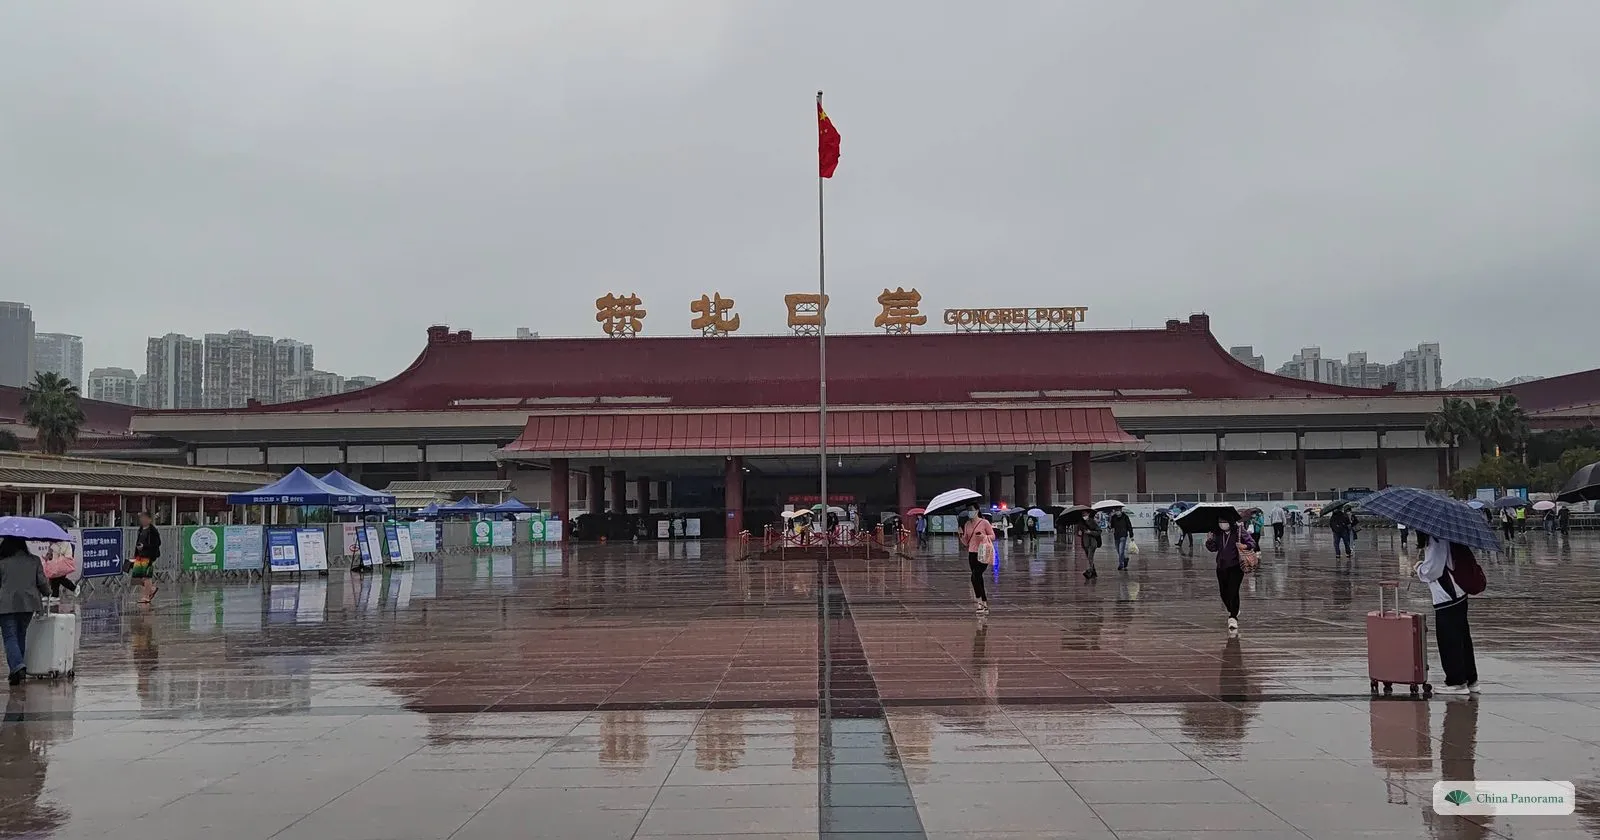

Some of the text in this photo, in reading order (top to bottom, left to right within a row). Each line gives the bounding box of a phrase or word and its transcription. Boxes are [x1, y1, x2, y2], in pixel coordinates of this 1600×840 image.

[596, 287, 928, 335] 拱北口岸
[944, 306, 1089, 325] GONGBEI PORT
